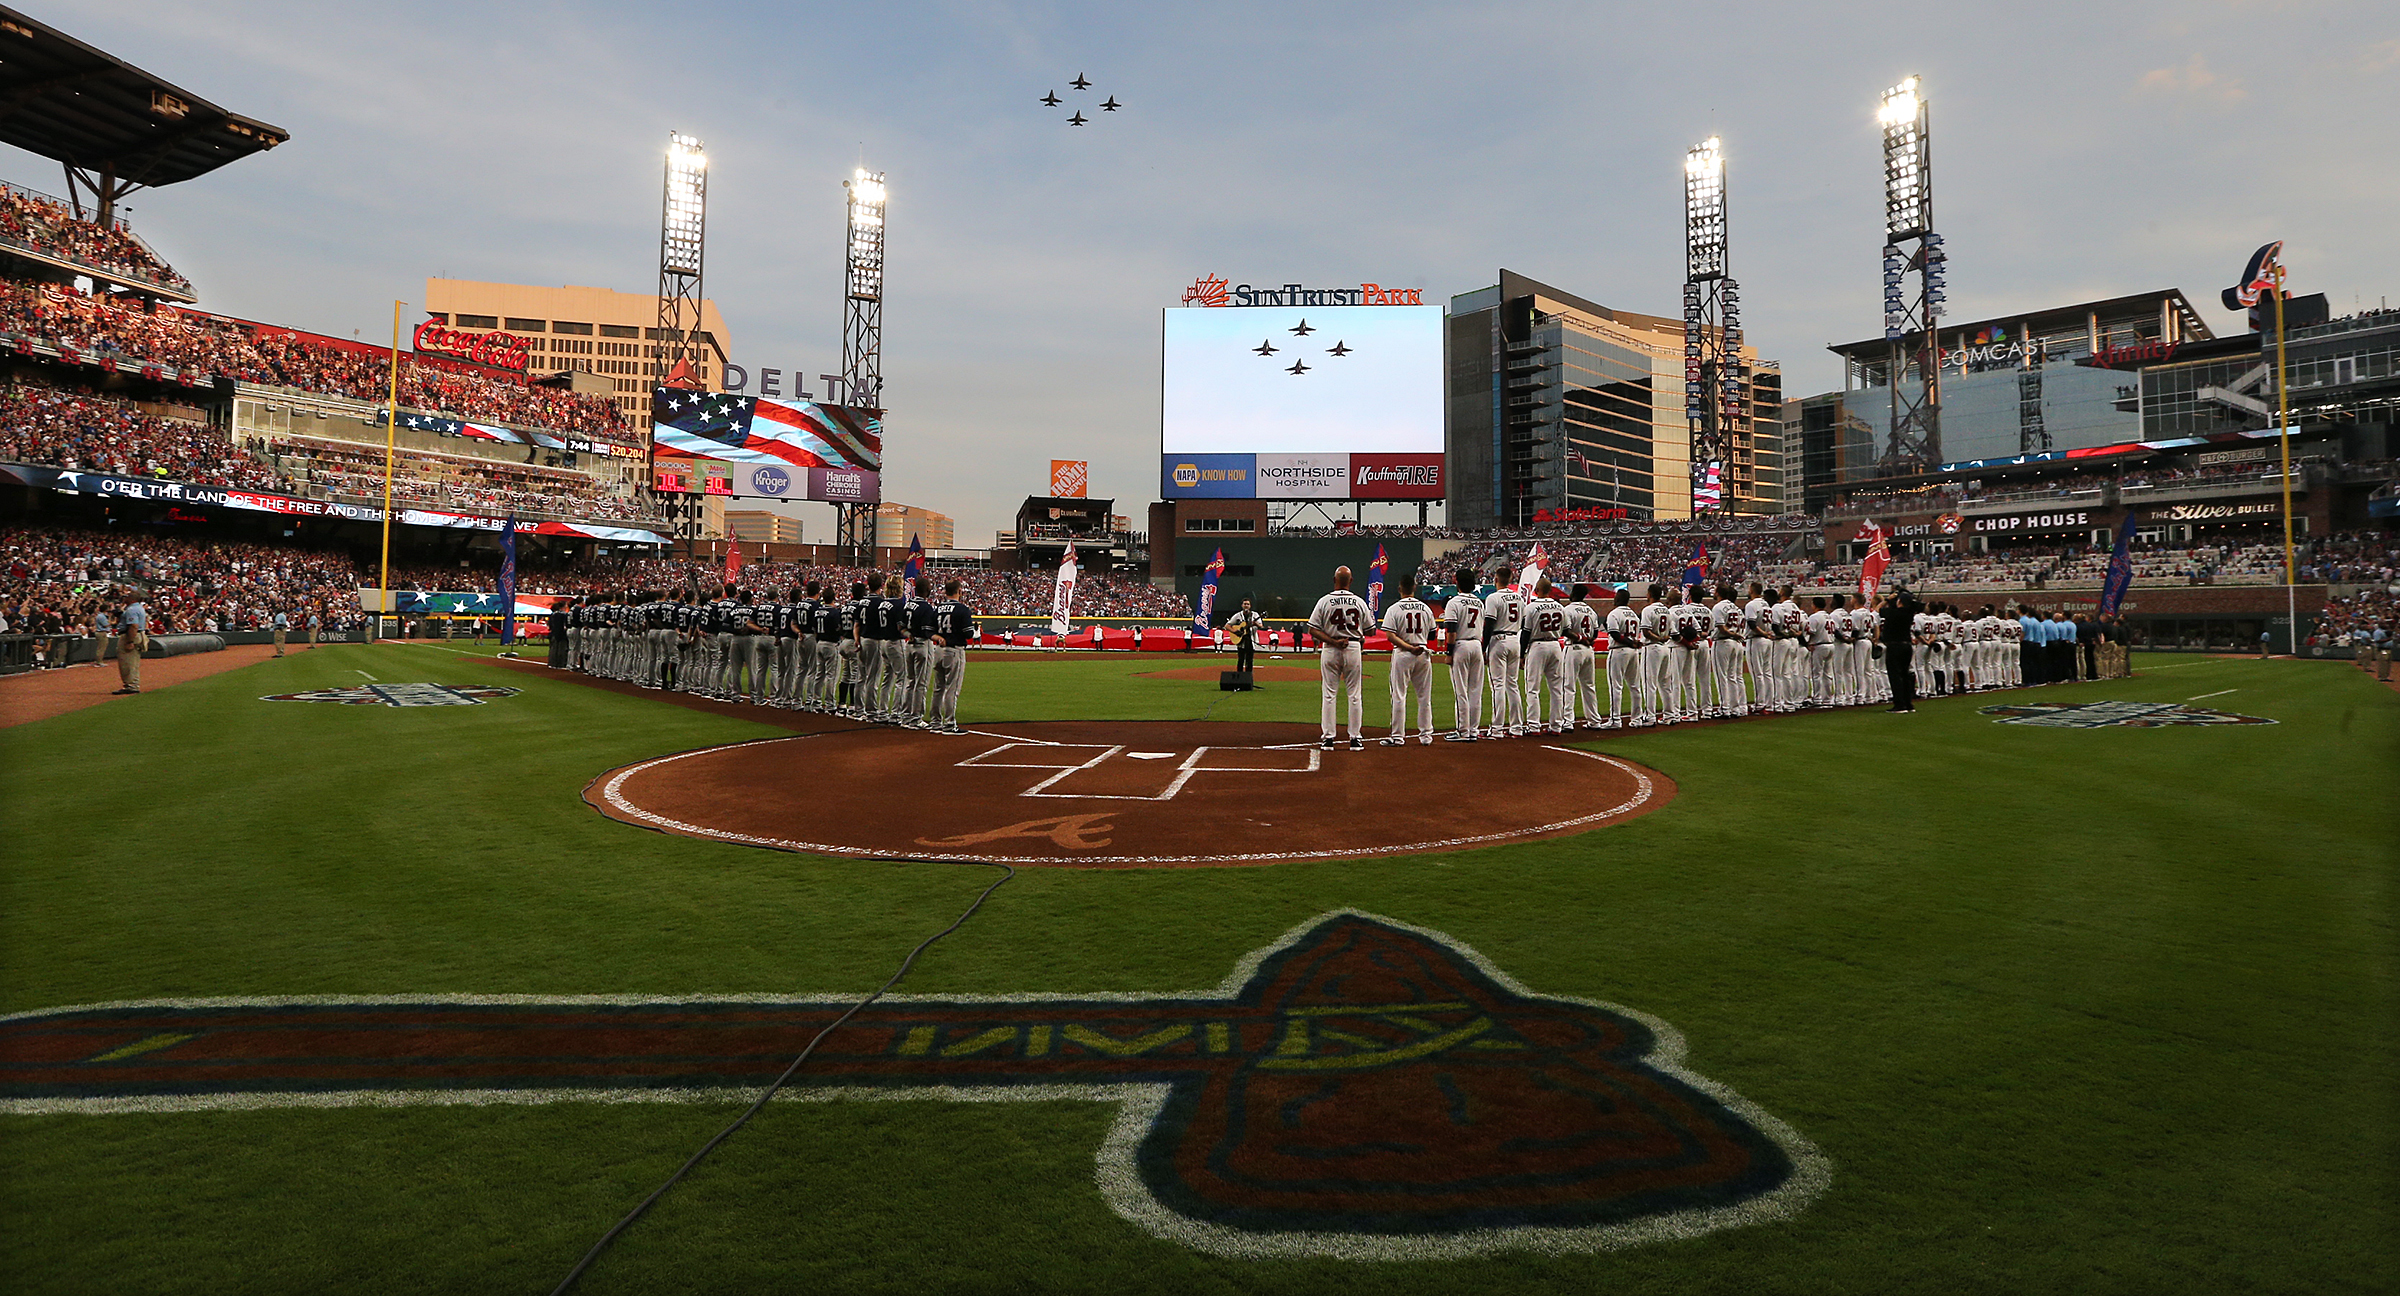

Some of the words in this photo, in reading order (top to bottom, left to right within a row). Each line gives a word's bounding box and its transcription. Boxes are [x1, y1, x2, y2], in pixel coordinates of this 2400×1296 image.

[14, 338, 34, 356] 31
[414, 317, 534, 370] Coca-Cola
[58, 347, 81, 365] 35
[2091, 339, 2180, 368] xfinity
[100, 358, 118, 373] 41
[141, 366, 163, 382] 44
[177, 373, 197, 388] 47
[722, 363, 873, 405] DELTA
[611, 445, 644, 459] $20,204
[2230, 450, 2264, 460] BURGER
[826, 471, 861, 483] Harrah's
[1051, 461, 1087, 496] HOME
[1054, 464, 1070, 478] THE
[1176, 469, 1197, 481] NAPA
[1202, 469, 1226, 481] KNOW
[1228, 469, 1246, 481] HOW
[1261, 467, 1345, 478] NORTHSIDE
[1356, 465, 1410, 485] Kauffman
[1396, 466, 1438, 485] TIRE
[705, 476, 724, 489] 30
[755, 470, 788, 493] Kroger
[826, 481, 861, 489] CHEROKEE
[1065, 475, 1087, 497] DEPOT
[1276, 479, 1330, 487] HOSPITAL
[101, 479, 143, 497] O'ER
[148, 484, 183, 499] THE
[186, 489, 229, 504] LAND
[234, 494, 252, 505] OF
[257, 498, 285, 510] THE
[288, 500, 322, 514] FREE
[325, 504, 358, 519] AND
[395, 511, 439, 525] HOME
[440, 515, 458, 526] OF
[458, 517, 488, 528] THE
[2151, 511, 2169, 520] THE
[2171, 503, 2236, 521] Silver
[2237, 504, 2276, 514] BULLET
[1894, 524, 1931, 536] LIGHT
[1975, 518, 2021, 531] CHOP
[2027, 513, 2088, 528] HOUSE
[1329, 597, 1357, 607] SNITKER
[2063, 602, 2097, 611] BELOW
[661, 610, 672, 622] 34
[757, 612, 773, 626] 22
[797, 610, 807, 625] 10
[860, 607, 867, 624] 4
[1330, 608, 1360, 631] 43
[1468, 608, 1479, 628] 7
[1508, 603, 1518, 622] 5
[780, 614, 787, 629] 8
[817, 618, 825, 633] 11
[937, 614, 952, 633] 14
[1405, 612, 1422, 634] 11
[1539, 613, 1562, 632] 22
[1581, 615, 1590, 633] 4
[1625, 619, 1637, 637] 13
[1659, 615, 1667, 633] 8
[1842, 618, 1852, 632] 38
[2271, 617, 2291, 625] 325
[328, 632, 347, 641] WISE
